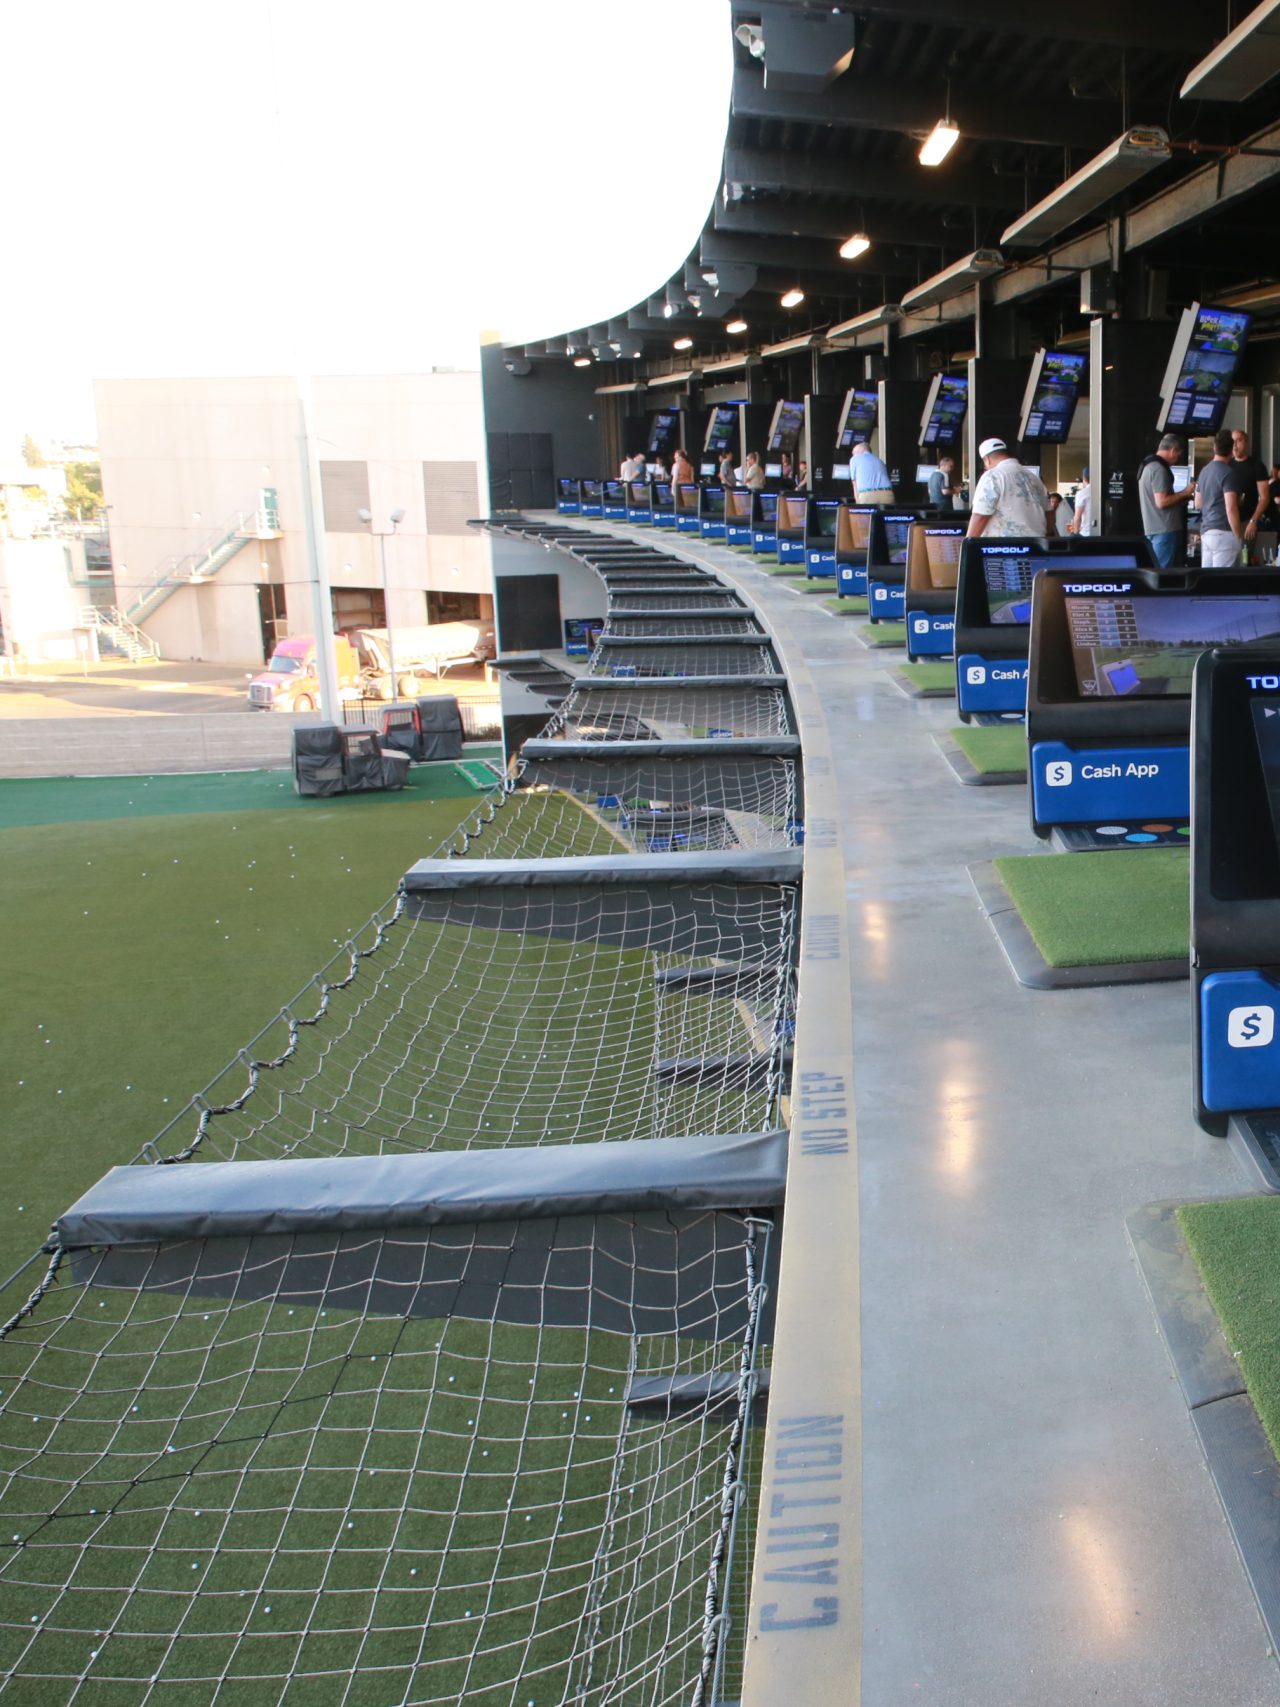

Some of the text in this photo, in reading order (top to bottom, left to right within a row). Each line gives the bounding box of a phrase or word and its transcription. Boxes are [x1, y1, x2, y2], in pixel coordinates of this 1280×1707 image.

[1063, 584, 1131, 592] TOPGOLF
[992, 669, 1020, 680] Cash
[1081, 764, 1122, 779] Cash
[1125, 763, 1159, 778] App
[800, 1072, 848, 1156] NO STEP
[760, 1415, 843, 1632] CAUTION
